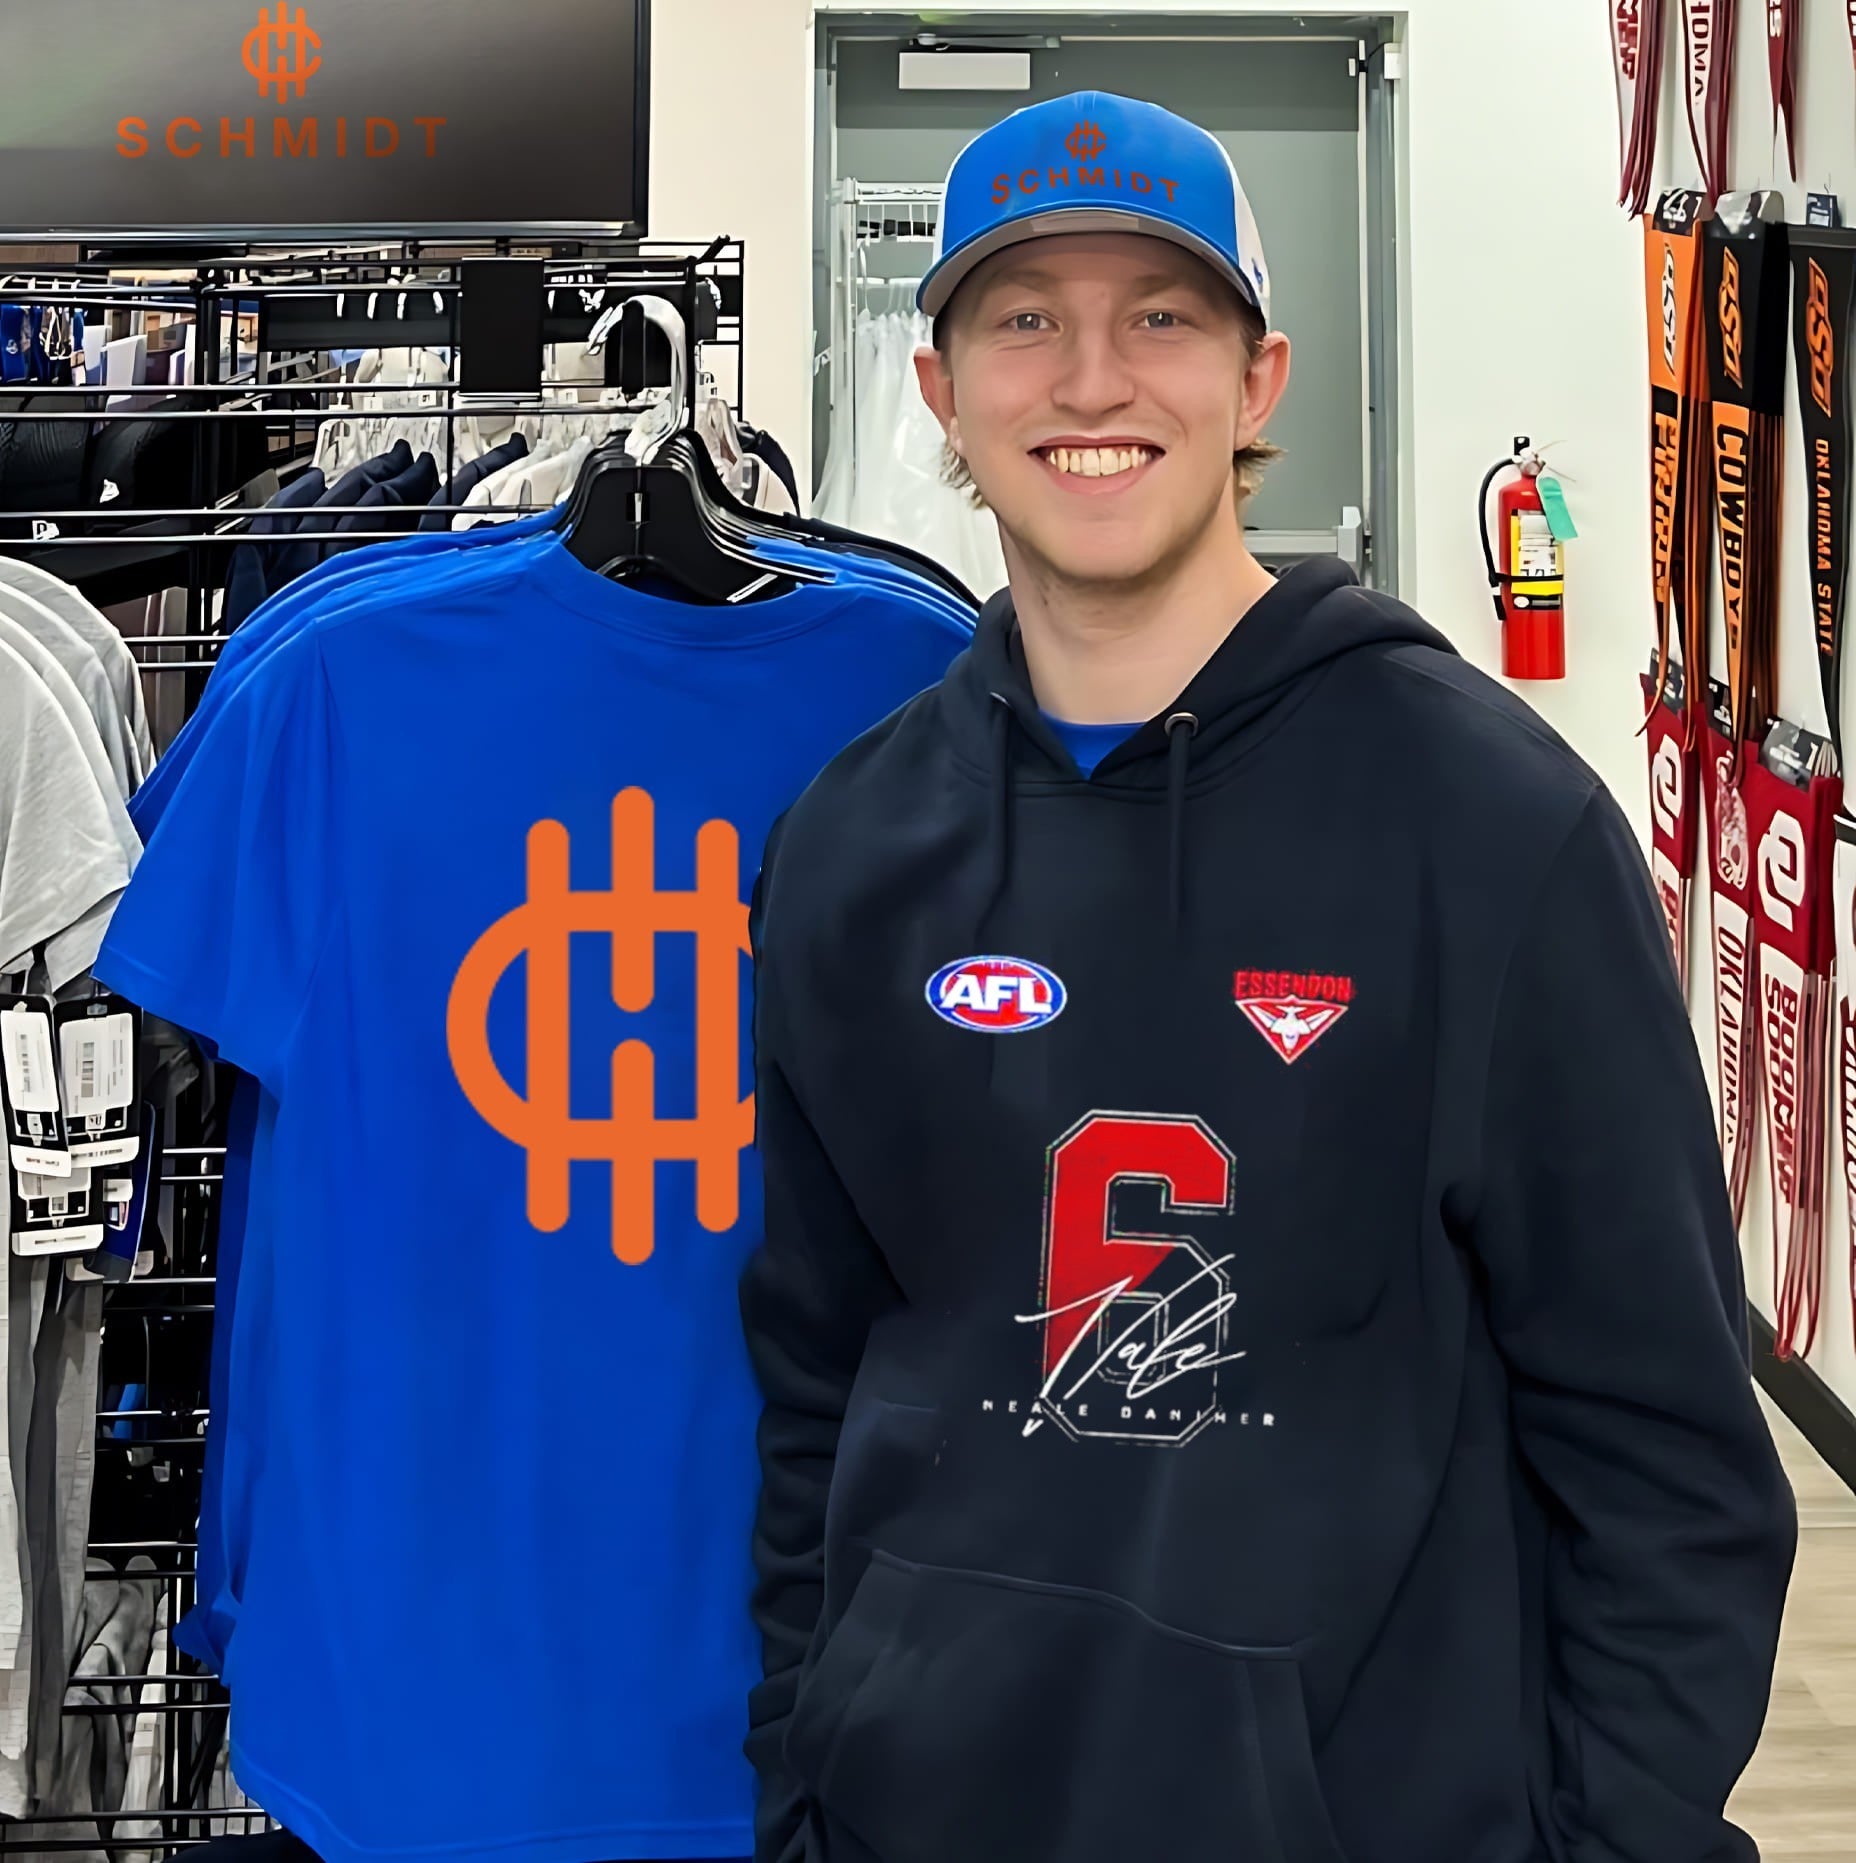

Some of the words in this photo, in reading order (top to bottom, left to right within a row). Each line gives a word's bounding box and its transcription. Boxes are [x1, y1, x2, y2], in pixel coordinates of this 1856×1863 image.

[115, 116, 448, 159] SCHMIDT
[991, 165, 1180, 205] SCHMIDT
[1815, 438, 1832, 571] OKLAHOMA
[939, 973, 1053, 1014] AFL
[1234, 969, 1352, 1003] ESSENDON
[1718, 925, 1745, 1145] OKLAHOMA
[1038, 1109, 1238, 1447] 6
[981, 1398, 1090, 1417] NEALE
